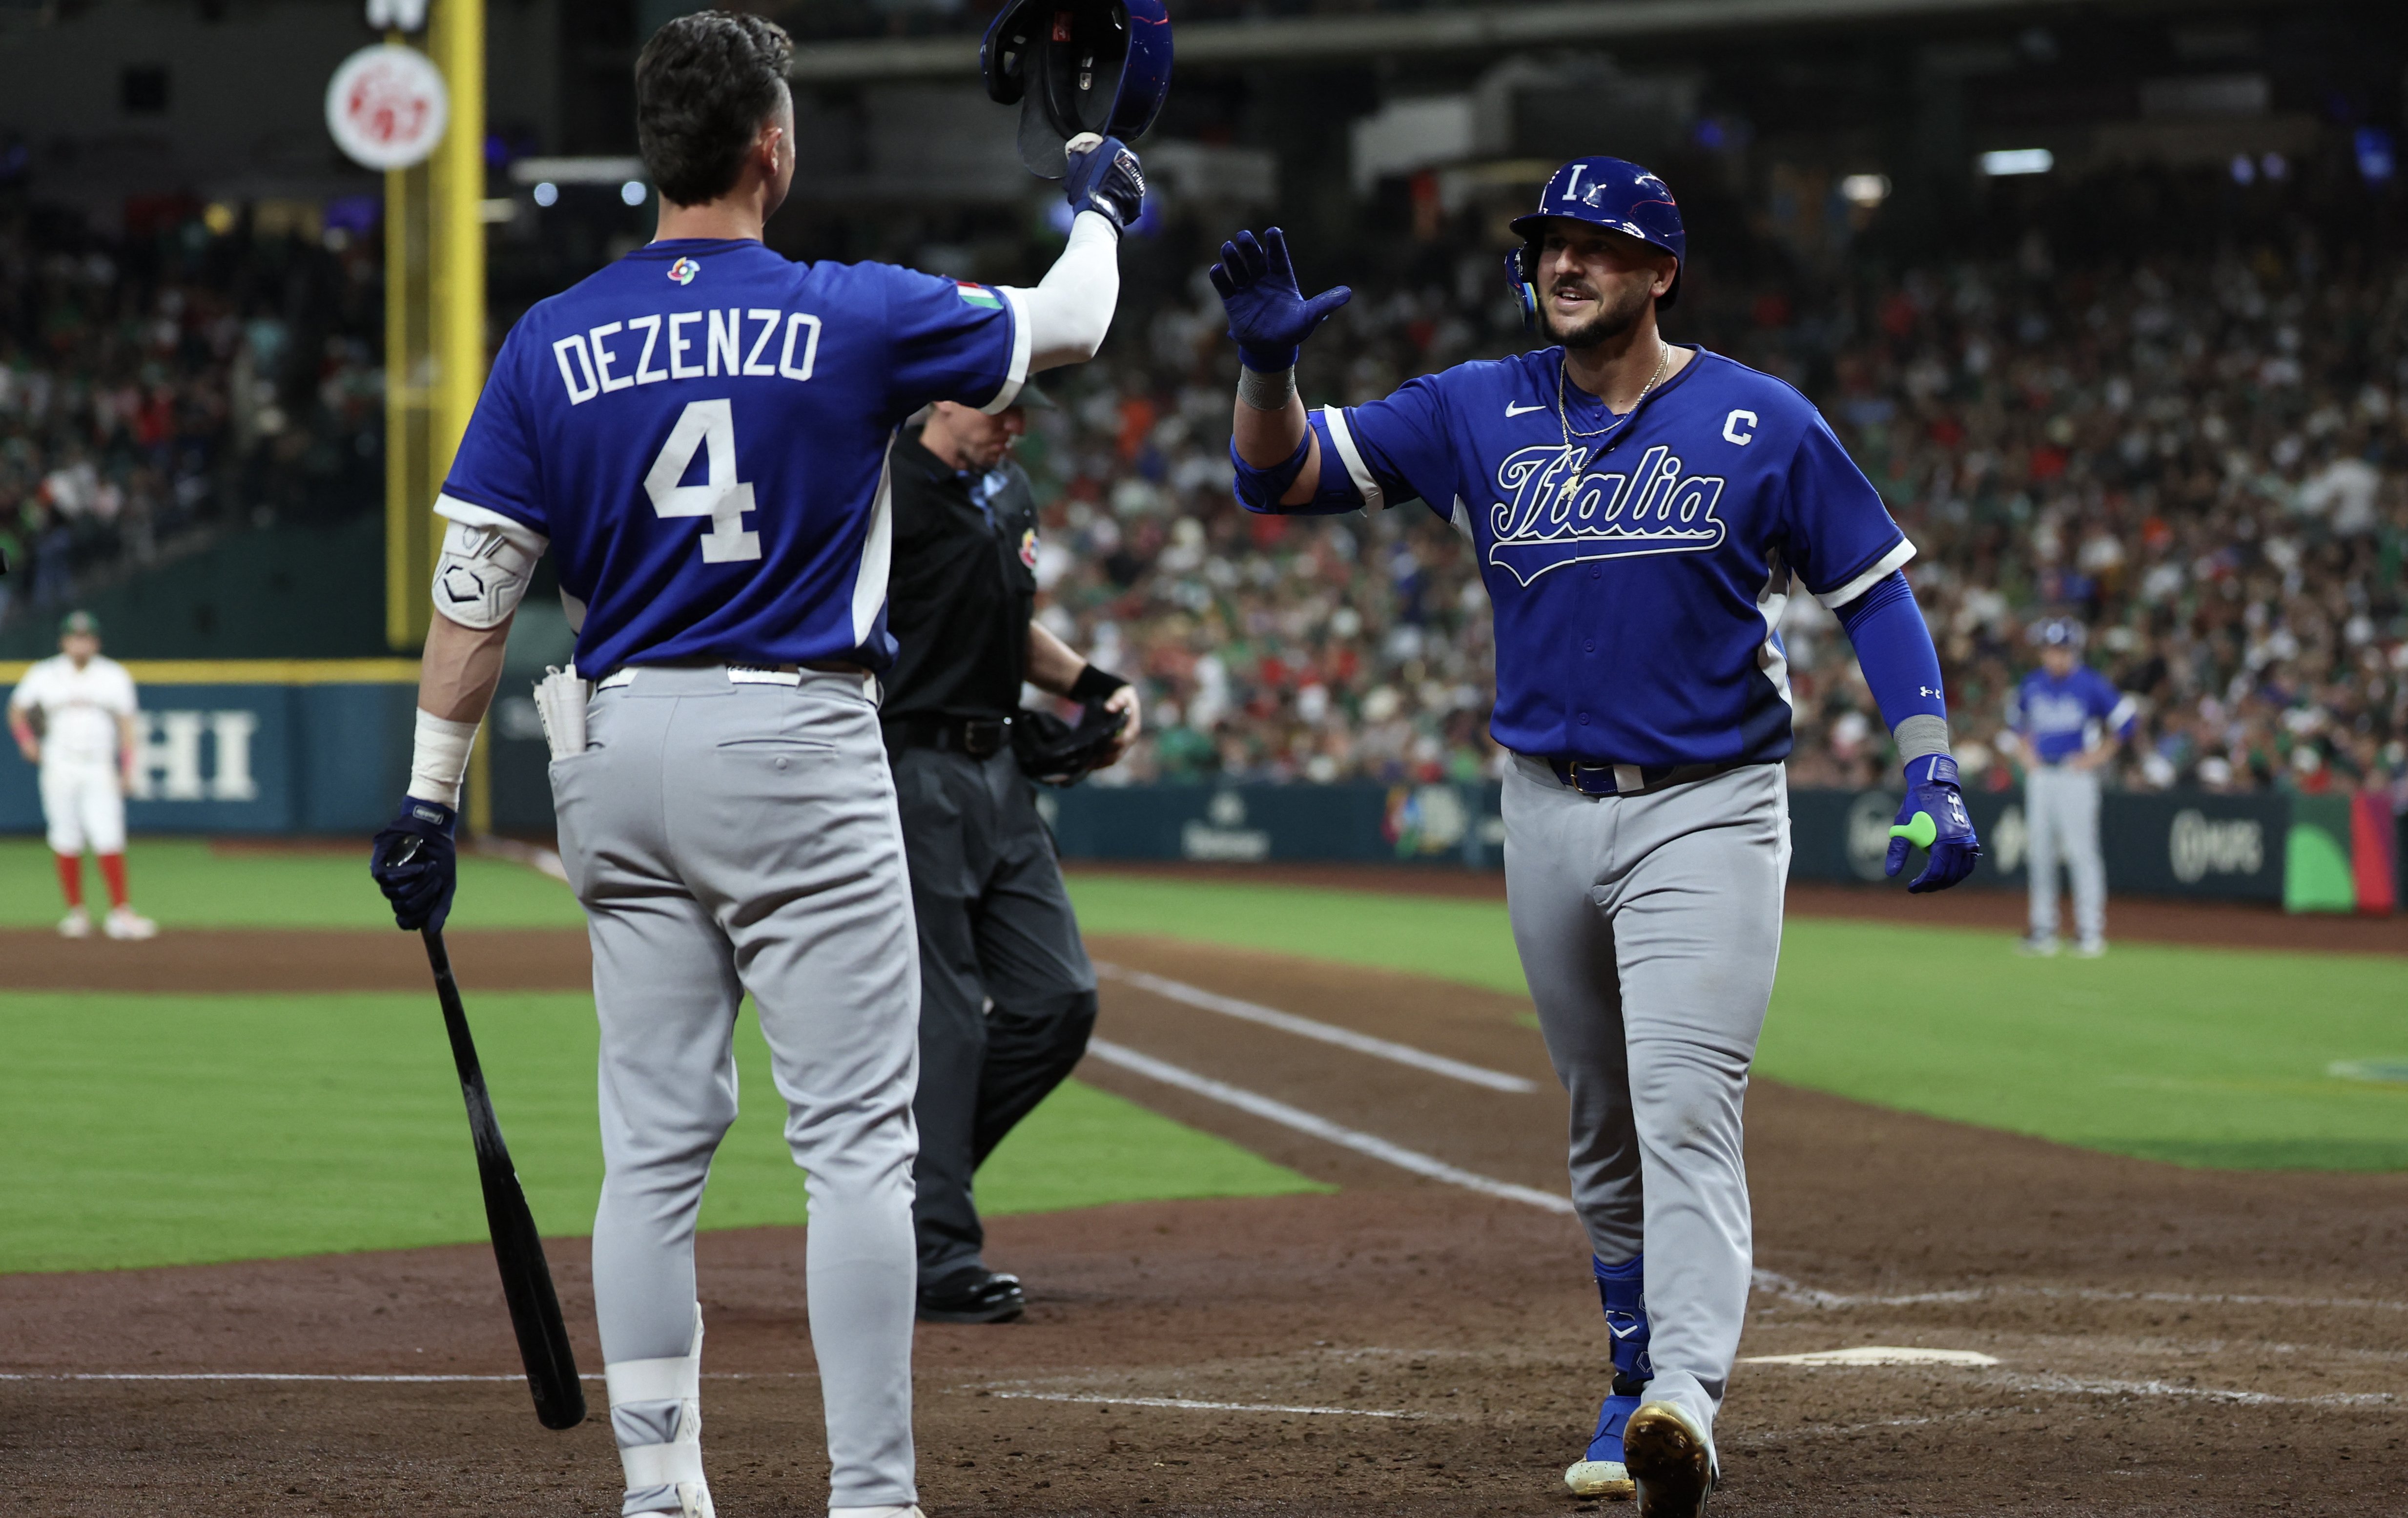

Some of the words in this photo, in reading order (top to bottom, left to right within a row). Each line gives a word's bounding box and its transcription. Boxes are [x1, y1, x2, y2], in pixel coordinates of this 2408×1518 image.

[1562, 165, 1588, 200] I
[553, 308, 822, 405] DEZENZO
[1722, 409, 1758, 446] C
[643, 398, 762, 563] 4
[1490, 445, 1726, 543] Italia
